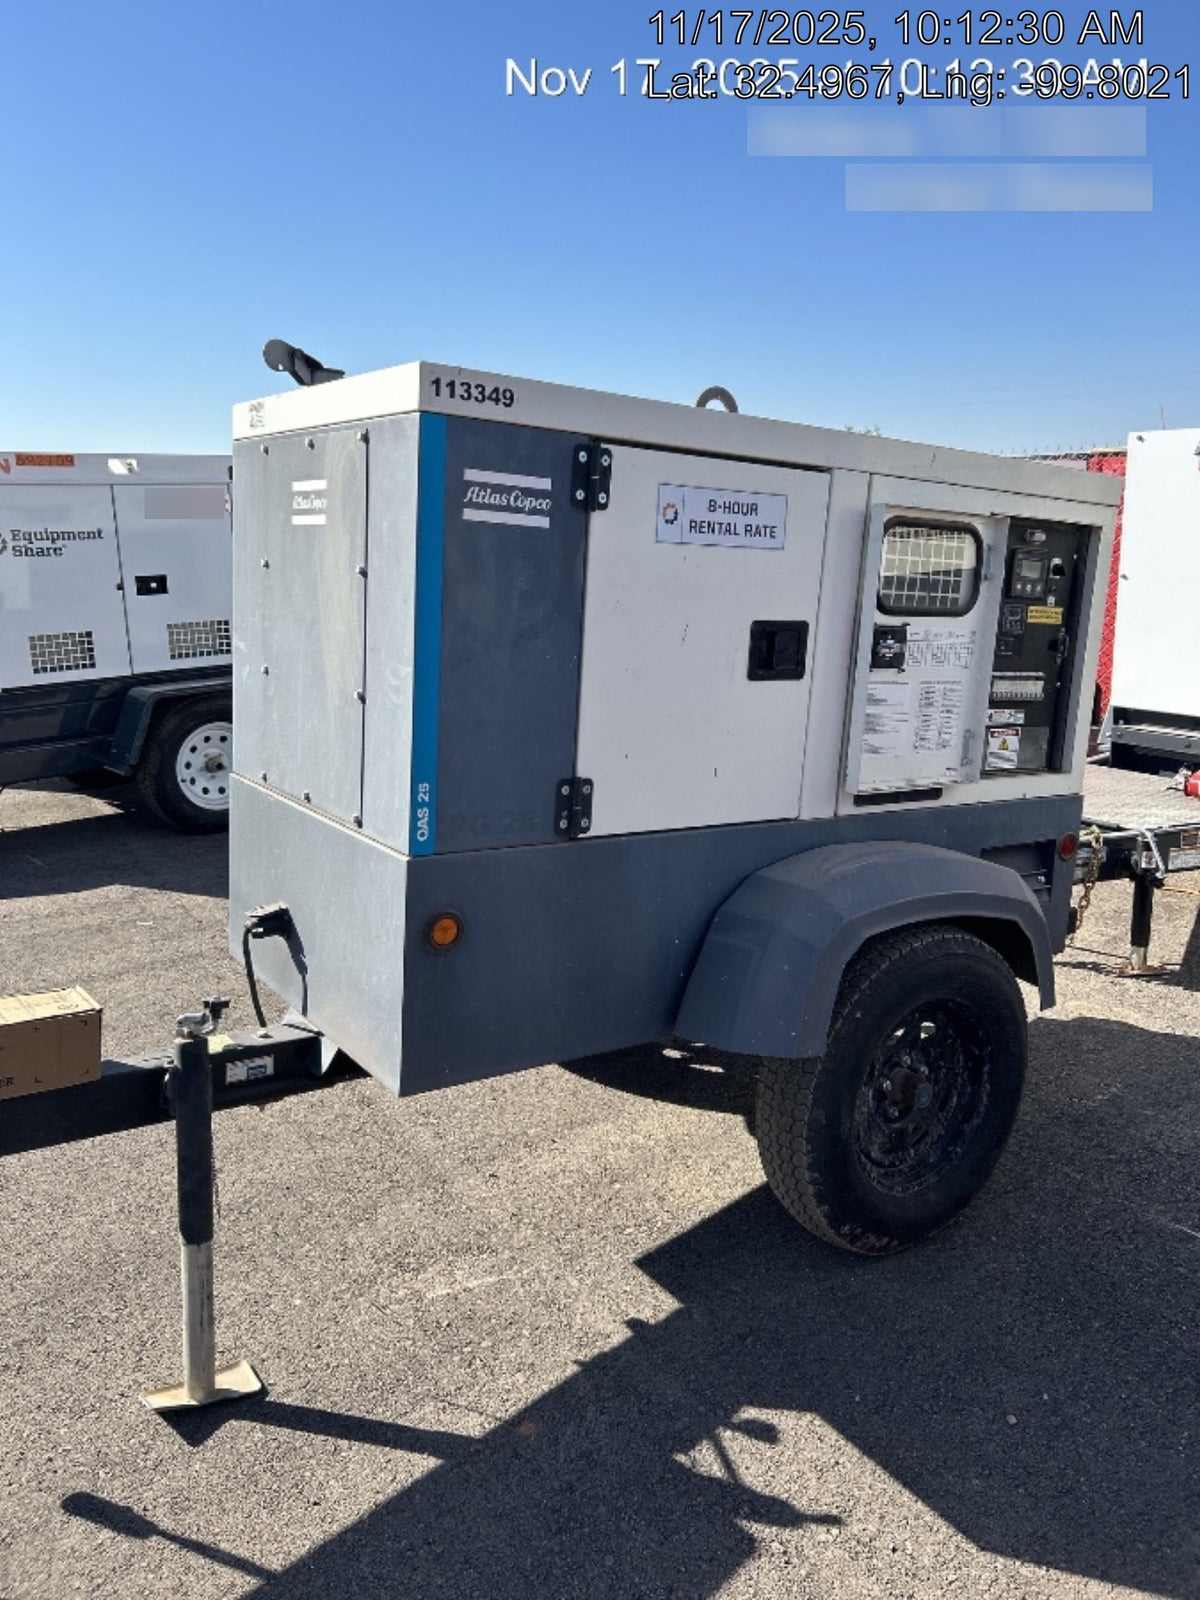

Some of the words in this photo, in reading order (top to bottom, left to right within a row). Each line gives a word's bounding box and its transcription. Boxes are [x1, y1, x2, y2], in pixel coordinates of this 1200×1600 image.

[431, 376, 515, 408] 113349
[10, 528, 104, 544] Equipment
[689, 519, 740, 536] RENTAL
[744, 523, 777, 539] RATE
[417, 783, 430, 803] 25
[416, 807, 430, 842] QAS
